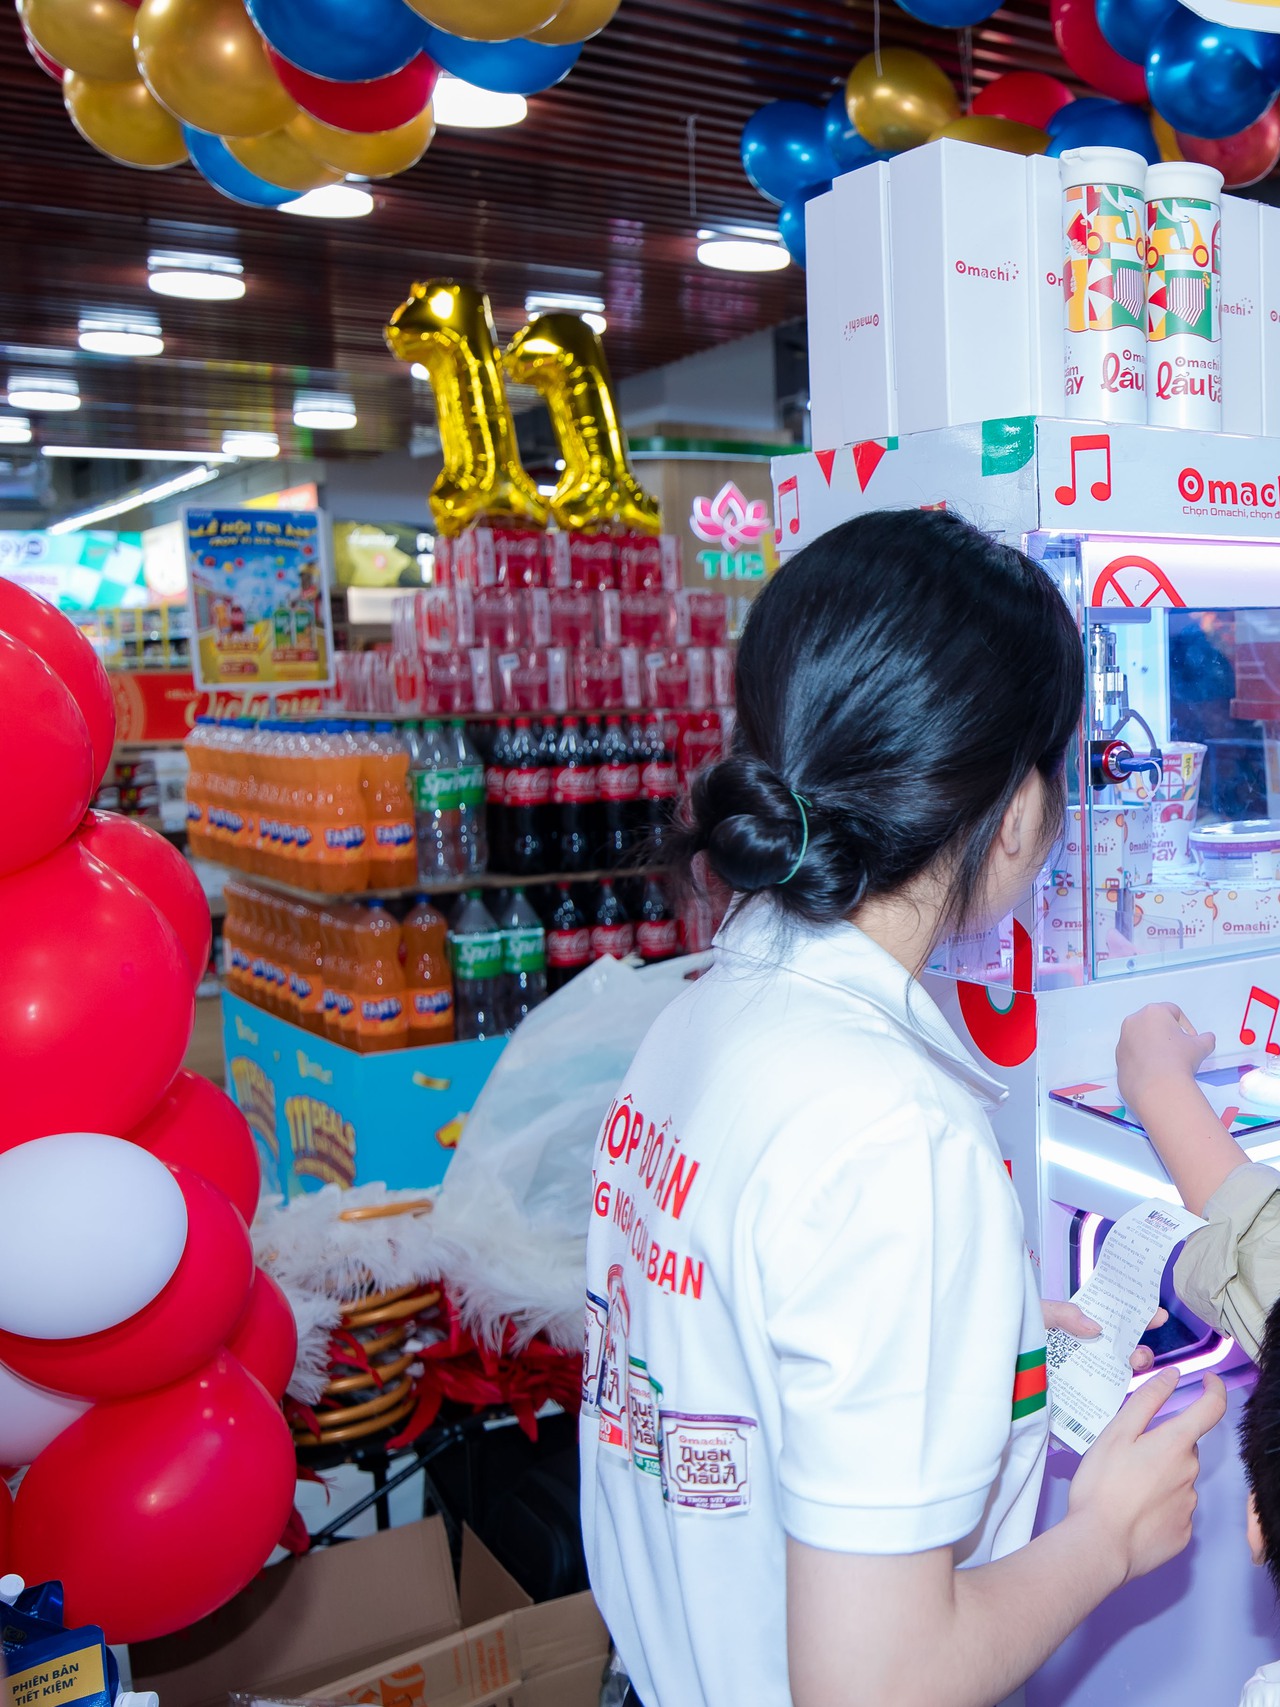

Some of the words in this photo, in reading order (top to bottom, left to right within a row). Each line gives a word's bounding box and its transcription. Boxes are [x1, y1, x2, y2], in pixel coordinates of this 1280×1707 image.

[955, 260, 1010, 282] Omachi
[1219, 303, 1246, 316] achi
[1175, 356, 1220, 372] Omachi
[1065, 375, 1085, 396] ay
[1182, 505, 1209, 517] Chọn
[1210, 507, 1249, 519] Omachi,
[1250, 509, 1273, 521] chọn
[1147, 925, 1197, 936] Omachi
[1223, 921, 1271, 932] Omachi
[646, 1240, 705, 1300] BẠN
[12, 1673, 49, 1695] PHIÊN
[52, 1662, 80, 1680] BẢN
[15, 1690, 39, 1707] TIẾT
